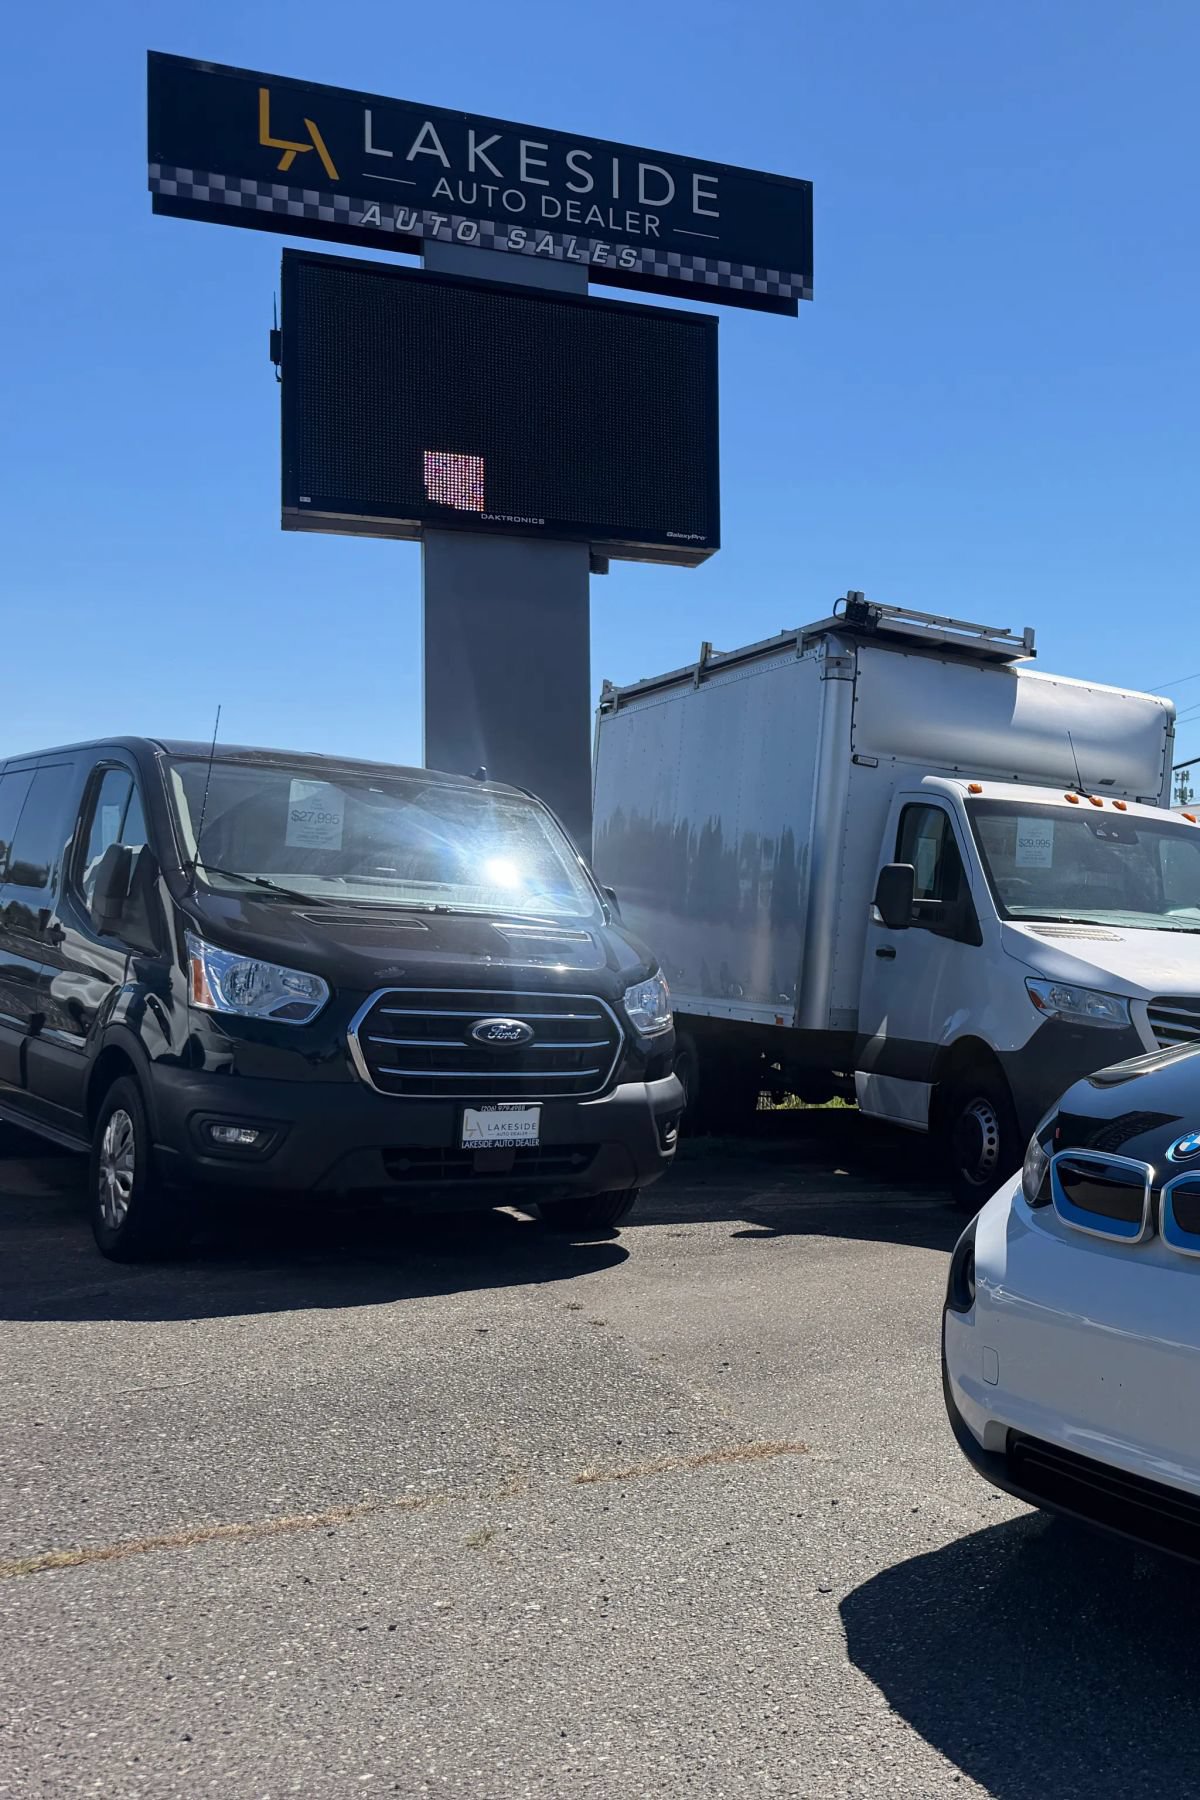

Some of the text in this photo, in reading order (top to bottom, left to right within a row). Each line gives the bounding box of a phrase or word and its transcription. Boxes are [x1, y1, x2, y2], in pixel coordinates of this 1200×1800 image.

[364, 108, 721, 219] LAKESIDE
[431, 176, 661, 239] AUTO DEALER
[360, 204, 639, 269] AUTO SALES
[480, 513, 545, 525] DAKTRONICS
[290, 809, 341, 825] $27,995
[487, 1025, 521, 1040] Ford
[487, 1122, 537, 1131] LAKESIDE
[461, 1138, 540, 1149] LAKESIDE AUTO DEALER
